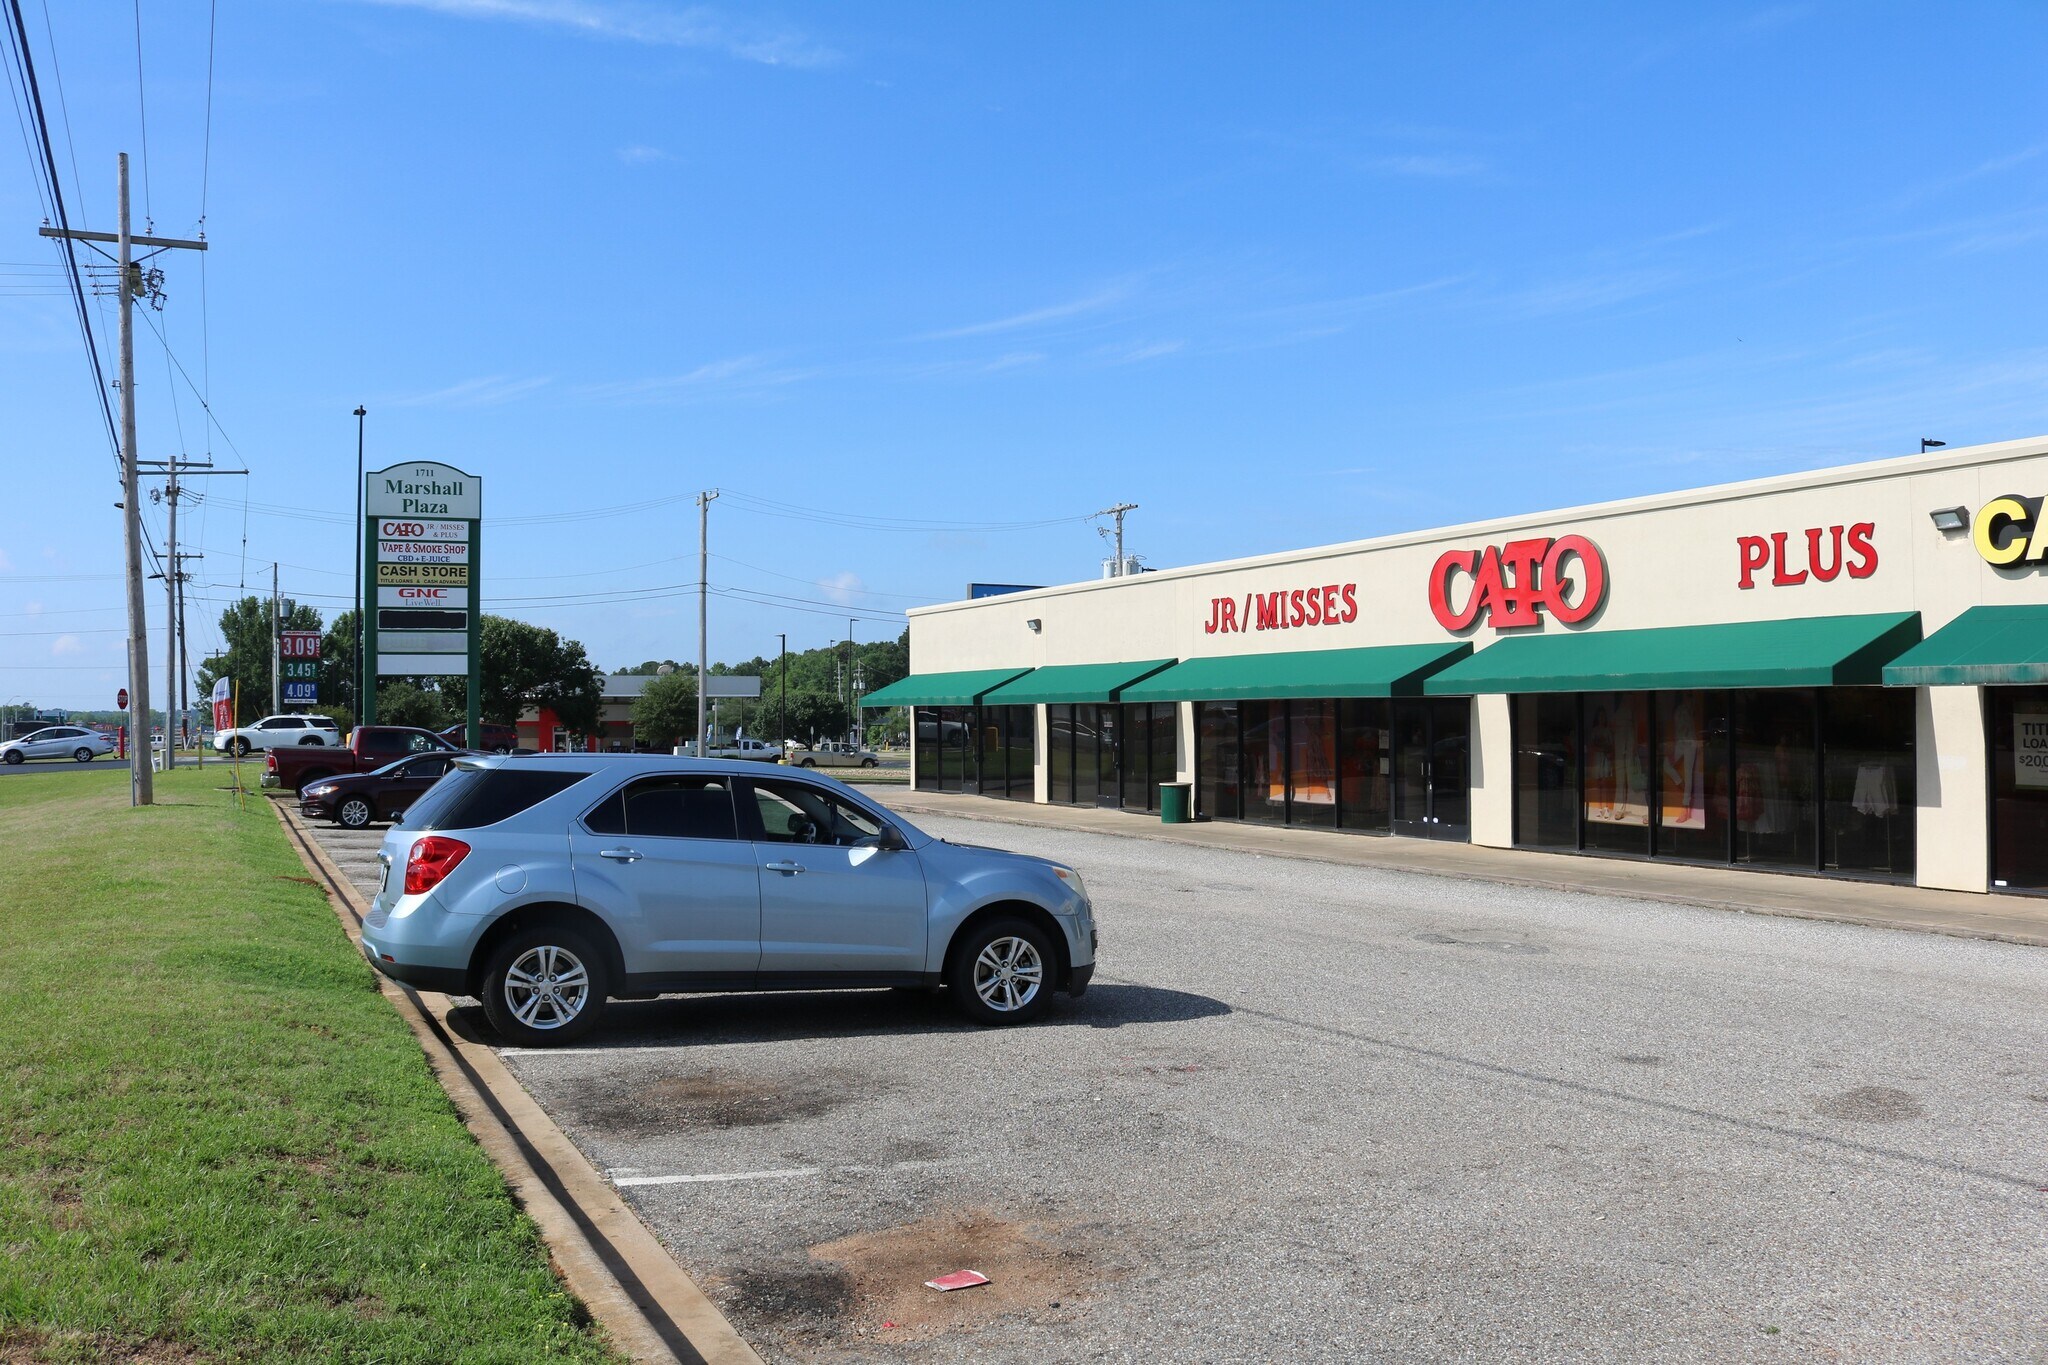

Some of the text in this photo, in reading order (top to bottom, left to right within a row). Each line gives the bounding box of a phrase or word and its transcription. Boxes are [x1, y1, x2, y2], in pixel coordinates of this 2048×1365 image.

[416, 469, 434, 477] 1711
[385, 479, 463, 496] Marshall
[402, 499, 448, 514] Plaza
[383, 522, 425, 537] CATO
[440, 523, 465, 531] MISSES
[405, 543, 411, 552] &
[413, 543, 442, 554] SMOKE
[444, 544, 466, 554] SHOP
[1736, 522, 1878, 590] PLUS
[380, 566, 467, 578] CASH STORE
[1428, 533, 1605, 632] CATO
[398, 588, 448, 598] GNC
